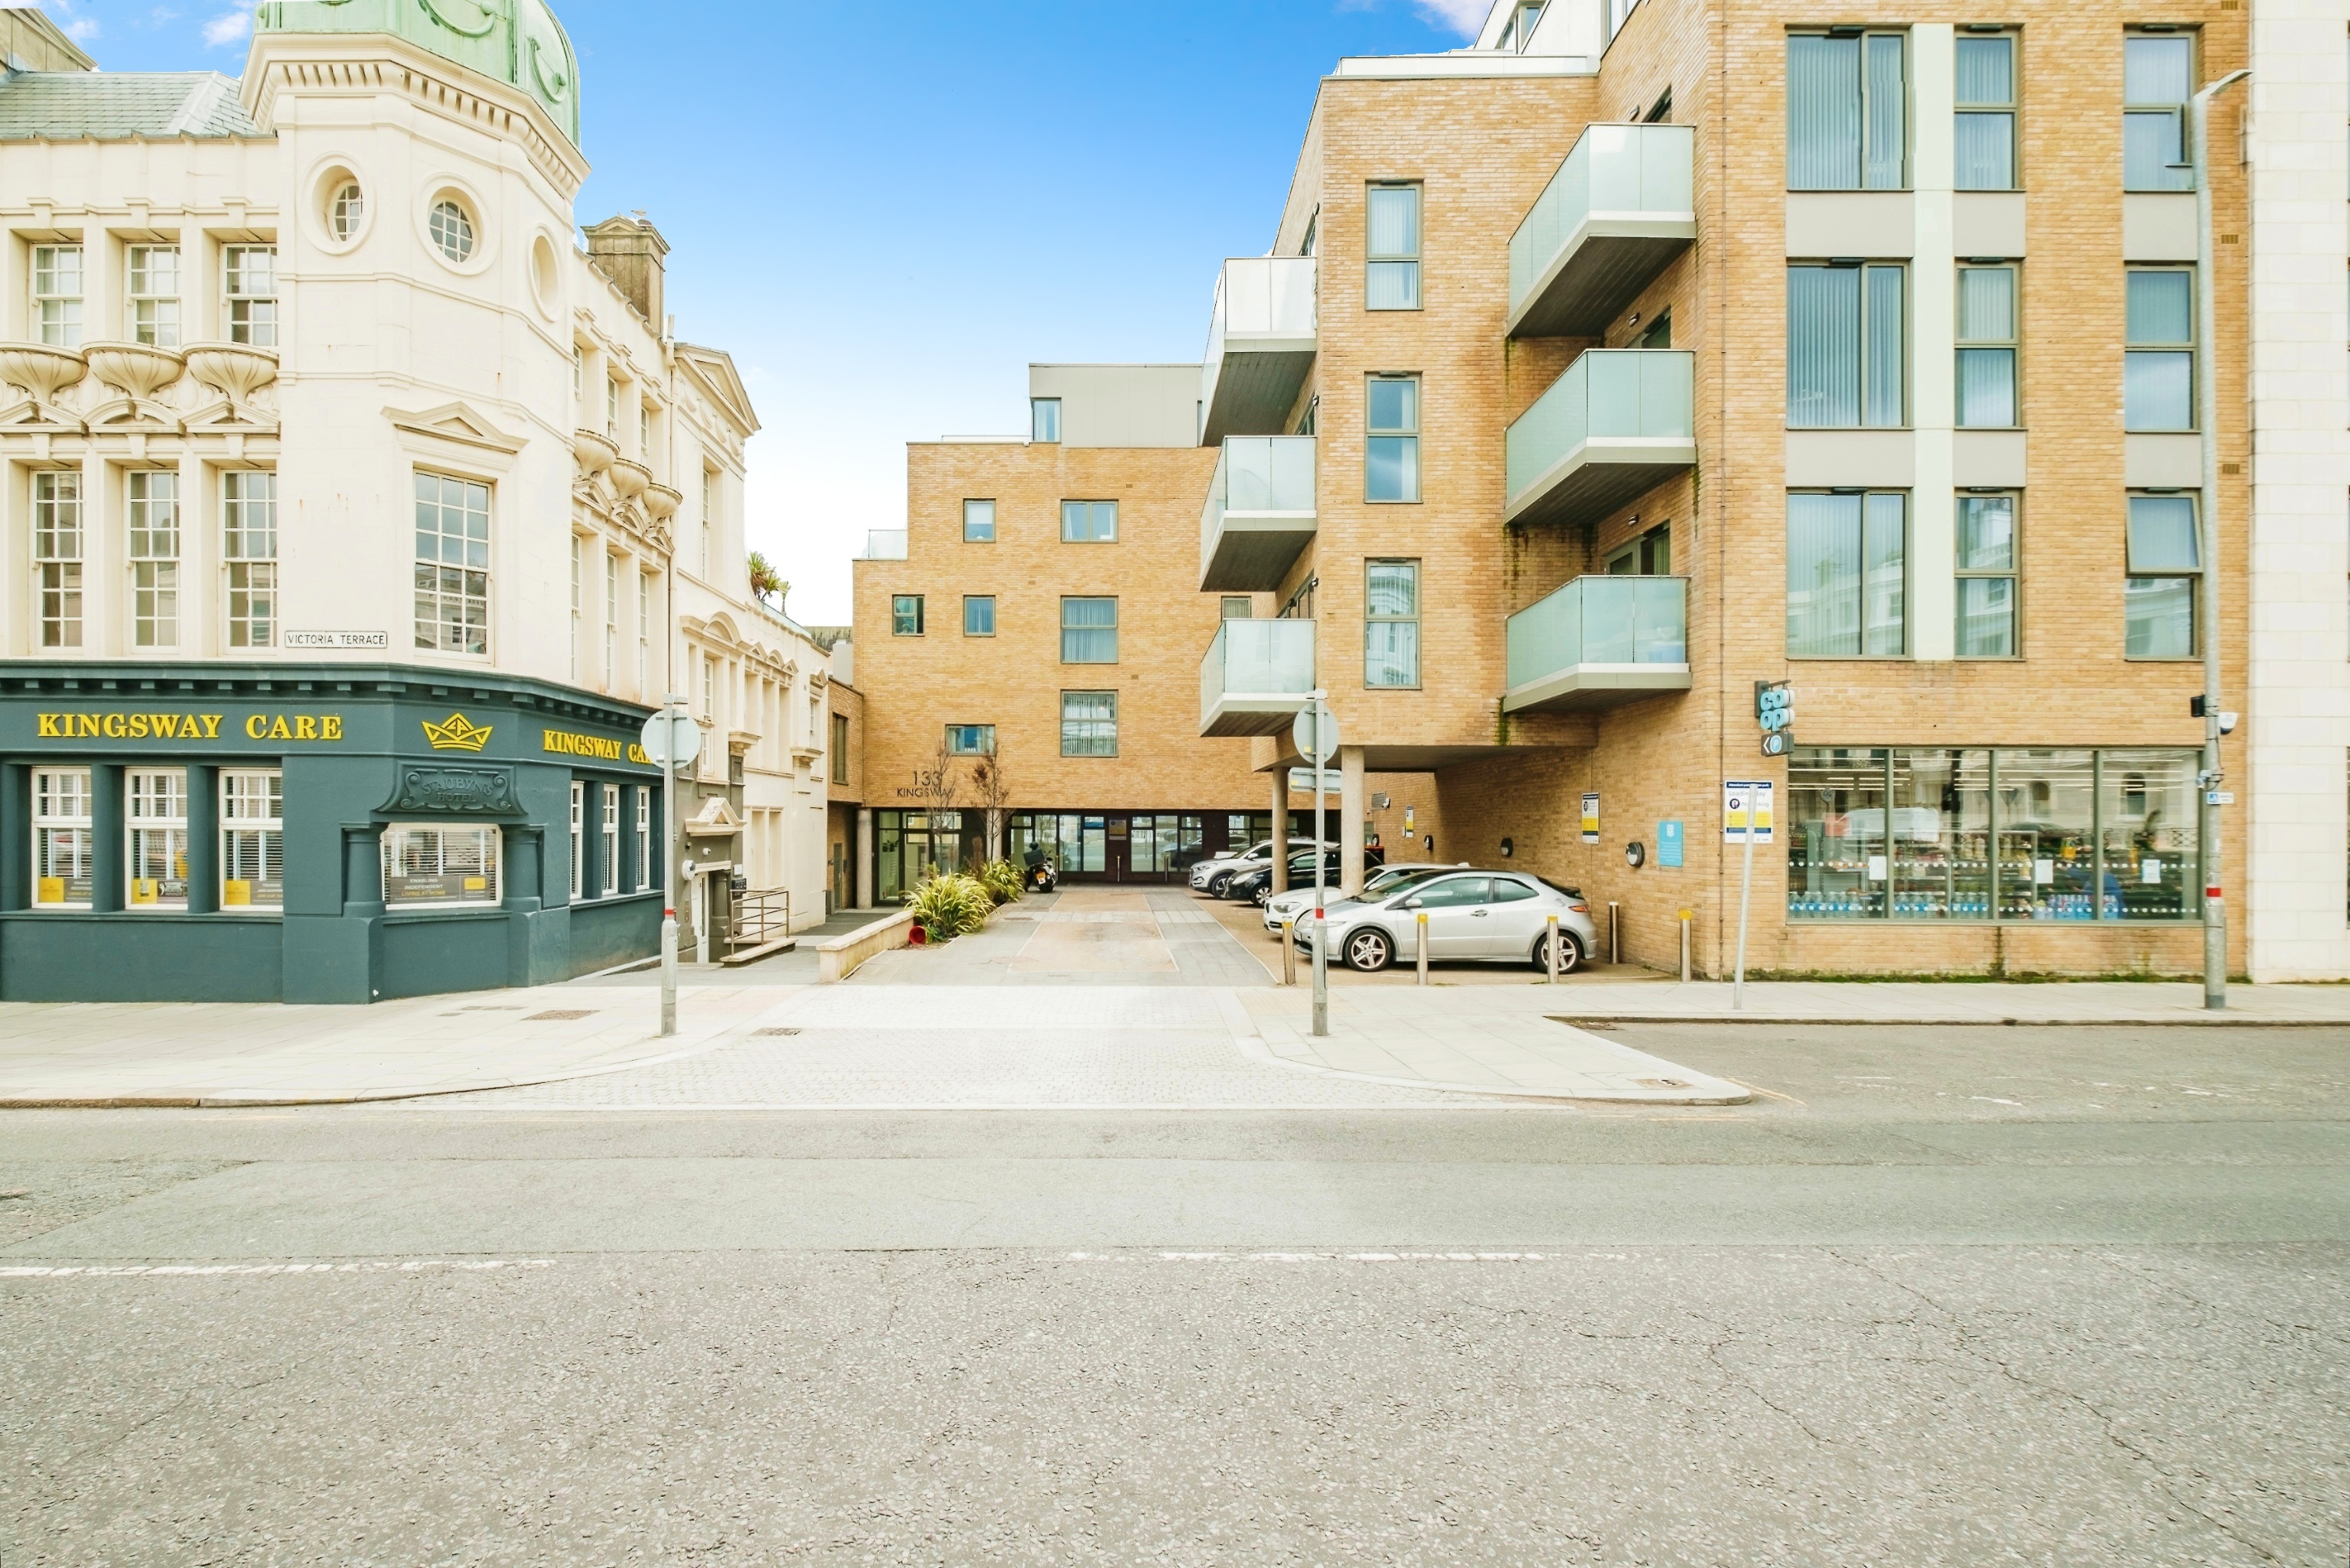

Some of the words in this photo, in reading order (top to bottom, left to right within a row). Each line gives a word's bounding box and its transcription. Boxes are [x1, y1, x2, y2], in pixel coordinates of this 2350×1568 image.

[288, 635, 333, 644] VICTORIA
[340, 635, 384, 644] TERRACE
[37, 713, 223, 738] KINGSWAY
[246, 714, 342, 740] CARE
[543, 730, 621, 760] KINGSWAY
[913, 771, 942, 786] 133
[437, 792, 476, 802] HOTEL
